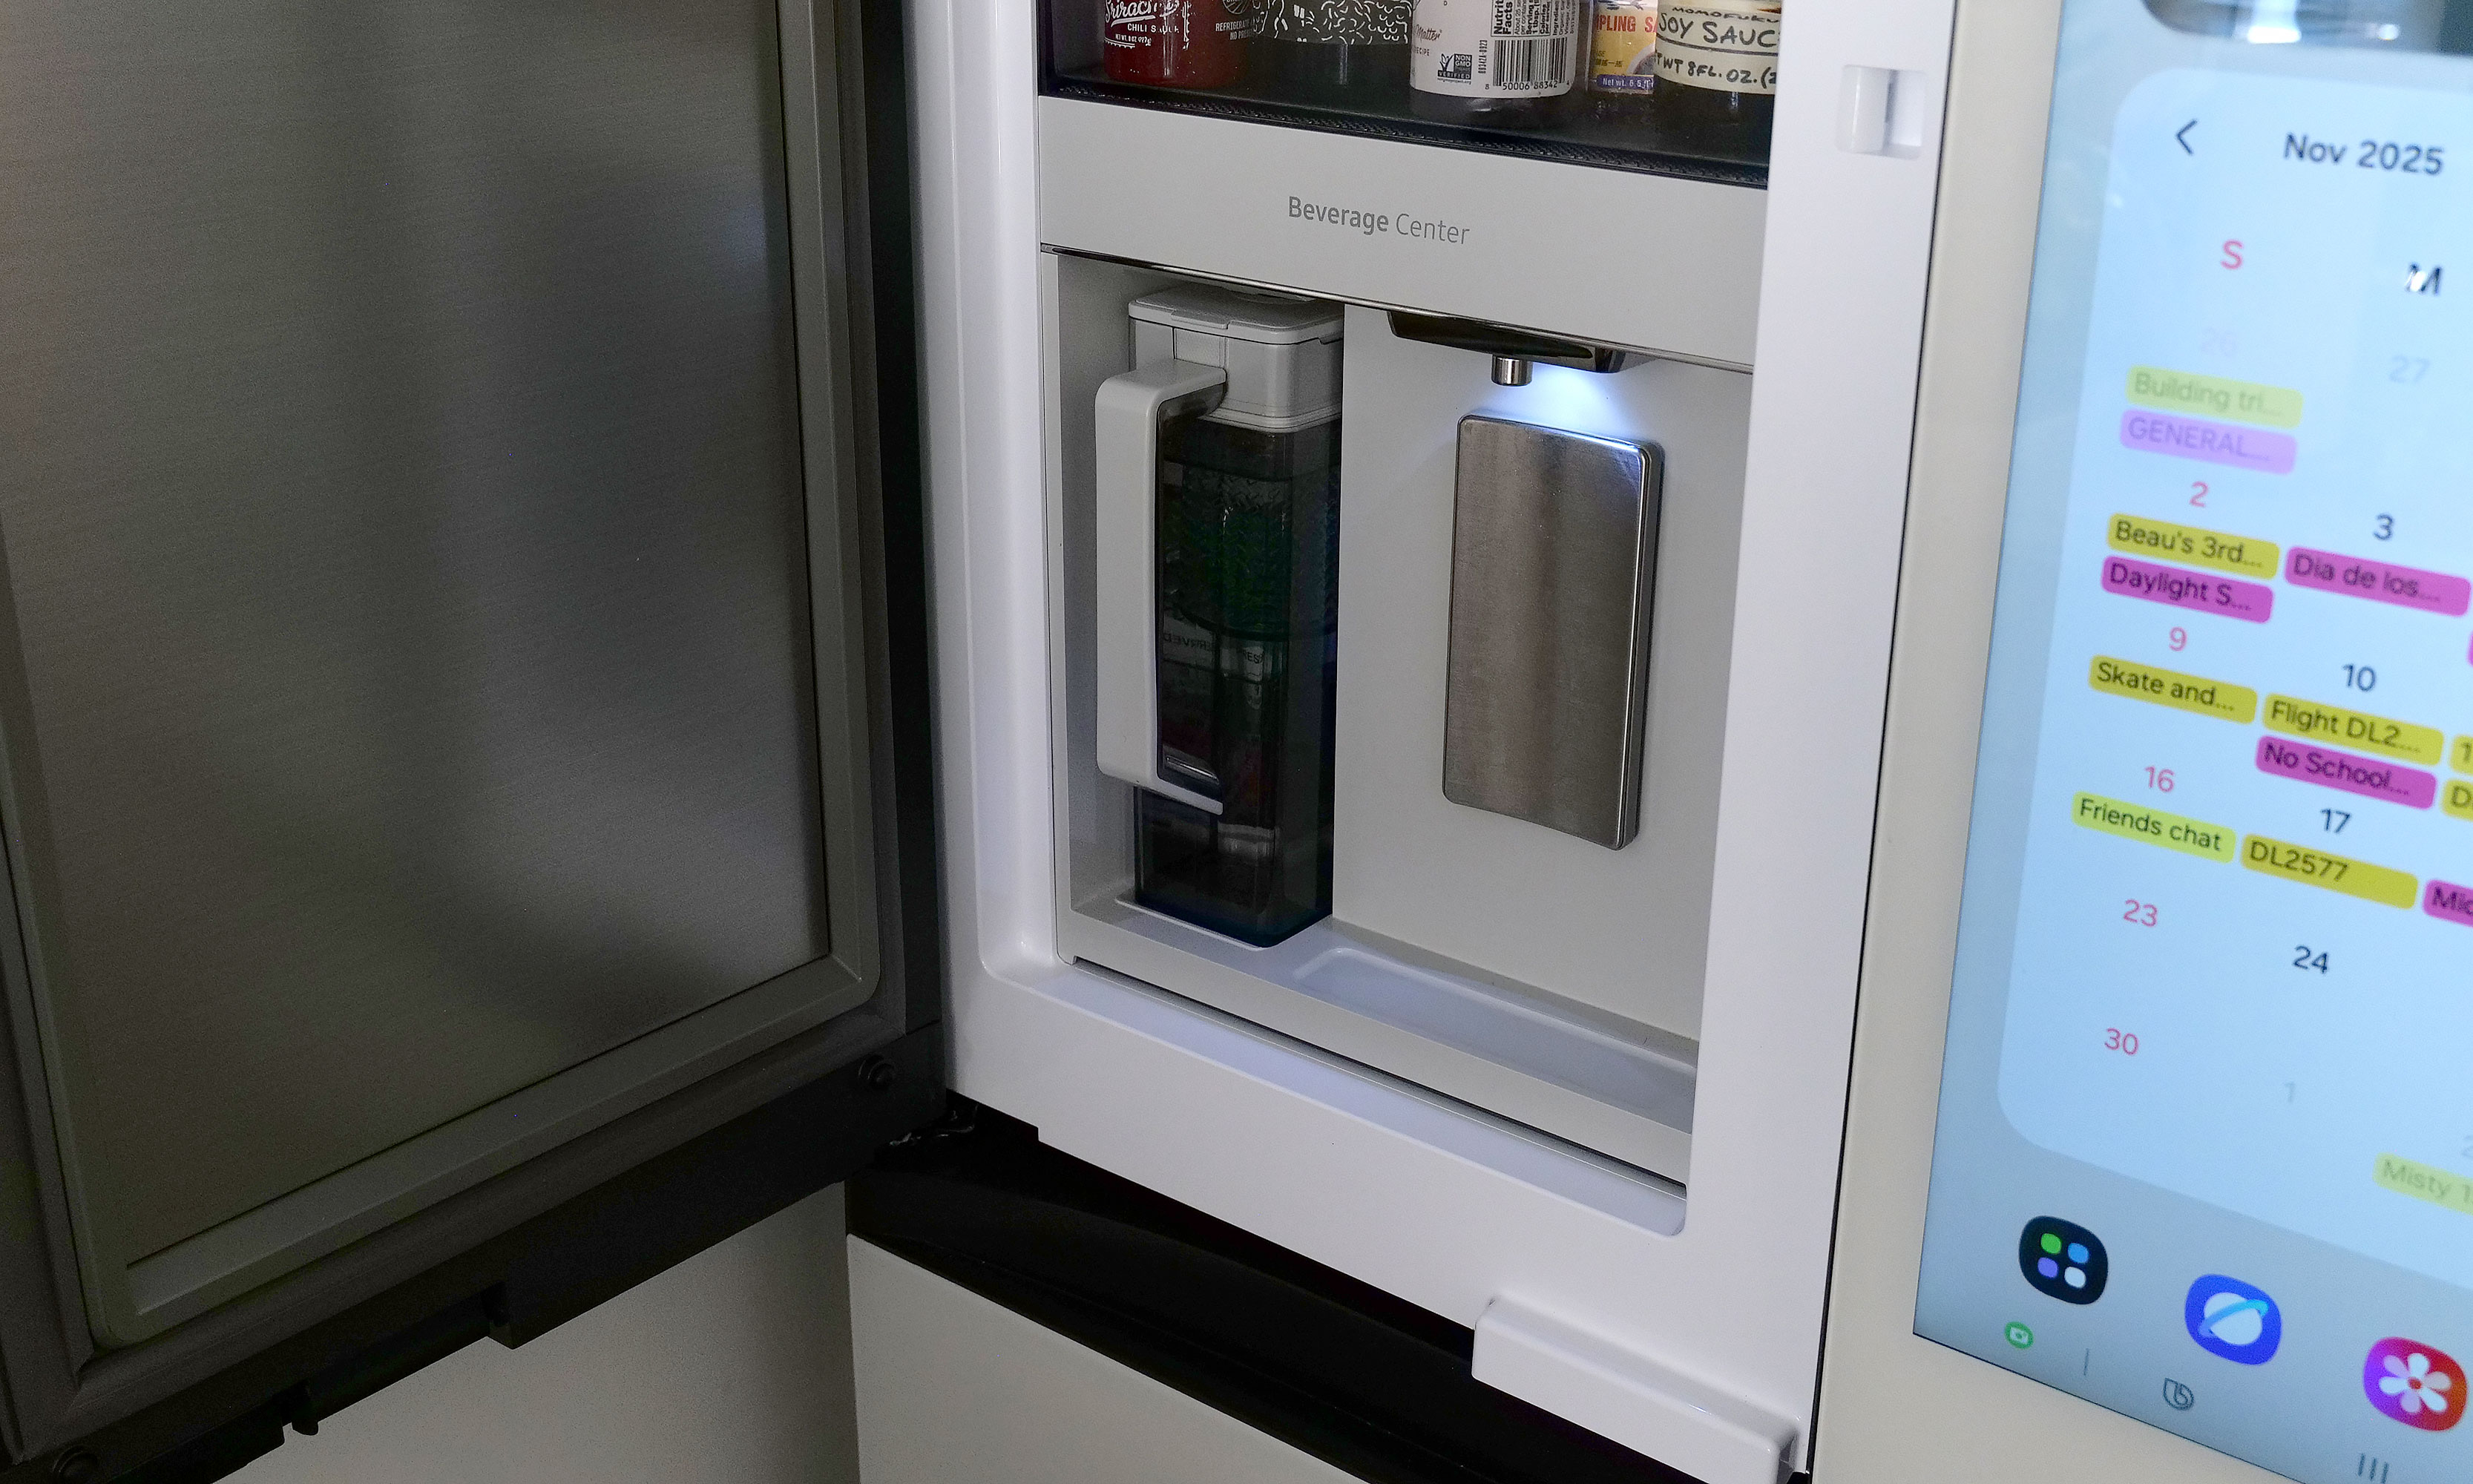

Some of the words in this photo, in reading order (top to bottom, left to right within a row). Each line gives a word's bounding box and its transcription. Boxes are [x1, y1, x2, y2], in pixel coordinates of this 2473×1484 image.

[1127, 23, 1147, 33] CHILI
[1502, 1, 1513, 35] Facts
[1658, 13, 1694, 39] SOY
[1702, 21, 1781, 48] SAUC
[1502, 82, 1530, 91] 50006
[1533, 80, 1557, 89] 88342
[1603, 77, 1614, 86] Net
[1726, 69, 1758, 84] OZ.
[2284, 133, 2347, 164] Nov
[2357, 139, 2444, 175] 2025
[1289, 196, 1389, 235] Beverage
[1396, 213, 1471, 245] Center
[2221, 240, 2244, 270] S
[2405, 263, 2443, 295] M
[2388, 353, 2431, 384] 27
[2134, 372, 2232, 413] Building
[2190, 481, 2209, 508] 2
[2115, 519, 2194, 554] Beau's
[2372, 513, 2394, 541] 3
[2109, 562, 2208, 602] Daylight
[2342, 565, 2375, 588] de
[2169, 626, 2187, 652] 9
[2097, 662, 2164, 695] Skate
[2342, 663, 2377, 692] 10
[2271, 700, 2339, 735] Flight
[2264, 741, 2300, 769] No
[2144, 765, 2175, 793] 16
[2080, 797, 2163, 836] Friends
[2169, 822, 2222, 852] chat
[2320, 807, 2351, 834] 17
[2250, 840, 2348, 882] DL2577
[2123, 899, 2158, 928] 23
[2292, 945, 2330, 975] 24
[2104, 1027, 2139, 1057] 30
[2283, 1080, 2296, 1104] 1
[2382, 1158, 2452, 1199] Misty
